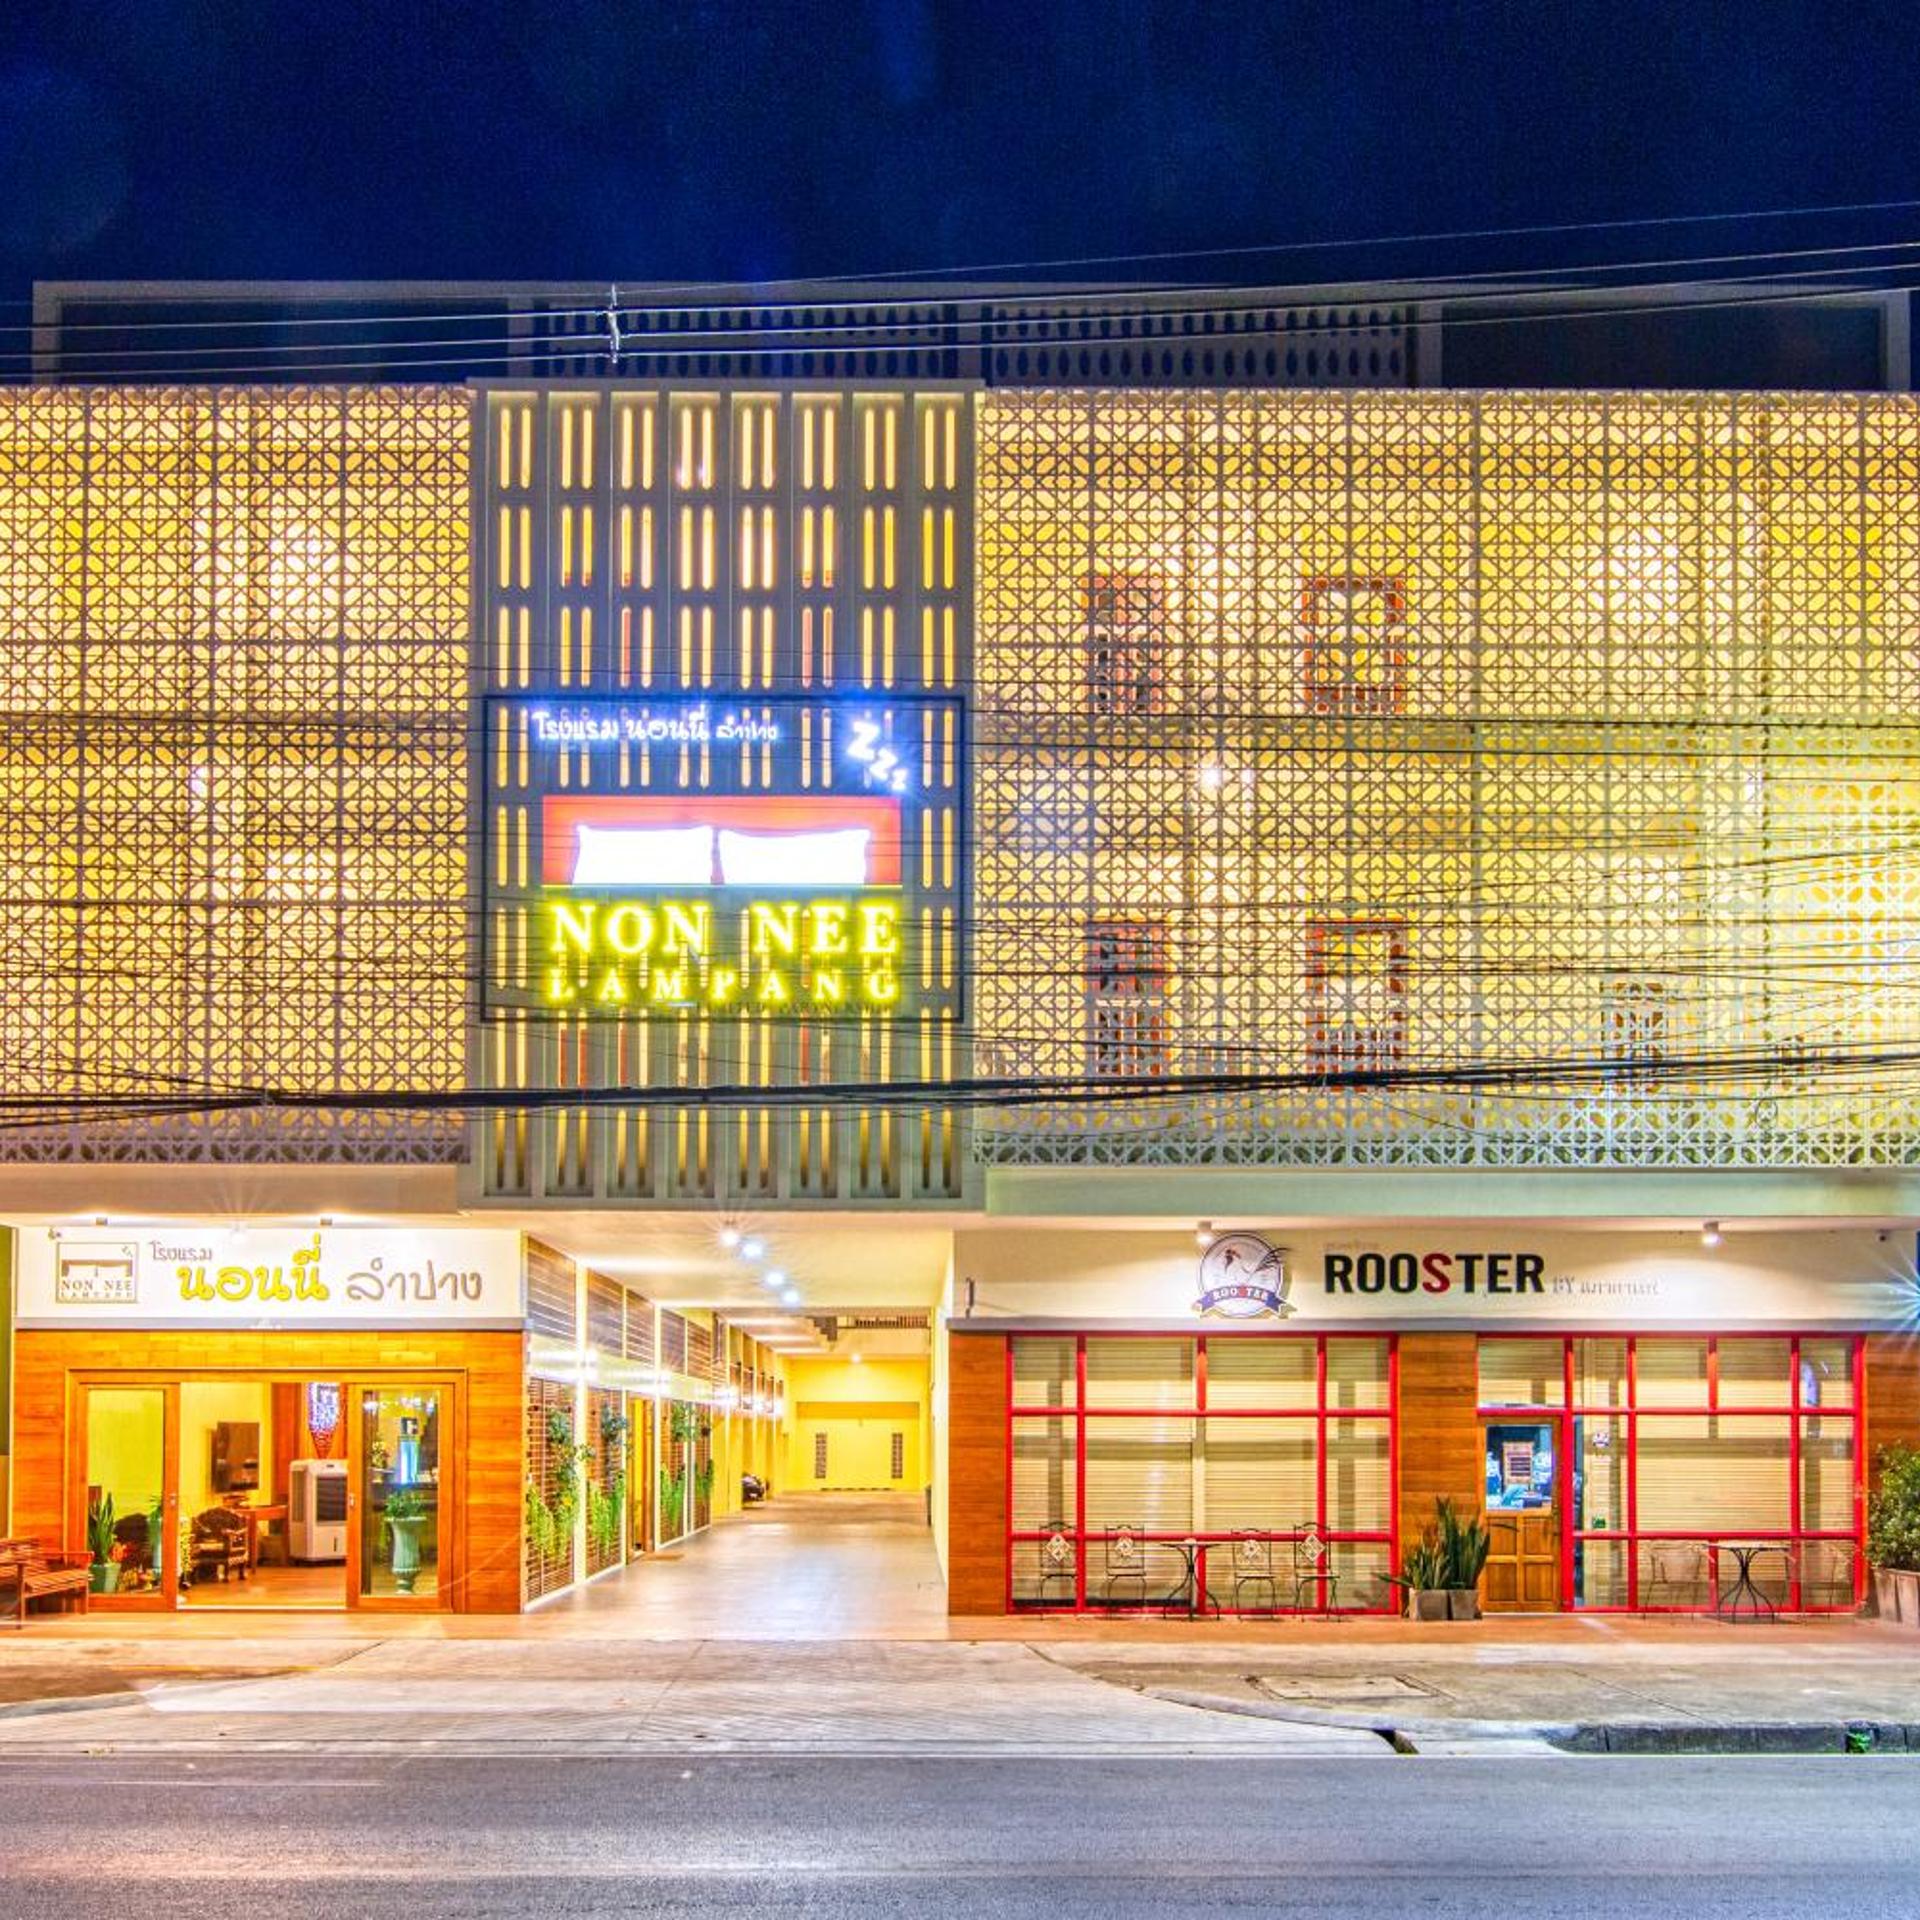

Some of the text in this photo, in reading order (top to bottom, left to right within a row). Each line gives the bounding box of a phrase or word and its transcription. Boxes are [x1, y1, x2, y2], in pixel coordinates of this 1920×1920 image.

[531, 710, 619, 740] โรงแรม
[625, 703, 710, 740] นอนนี่
[550, 904, 897, 954] NON NEE
[549, 968, 897, 1001] LAMPANG
[149, 1240, 213, 1262] โรงแรม
[176, 1232, 483, 1302] นอนนี่ ลำปาง
[61, 1279, 132, 1291] NON NEE
[1325, 1252, 1545, 1294] ROOSTER
